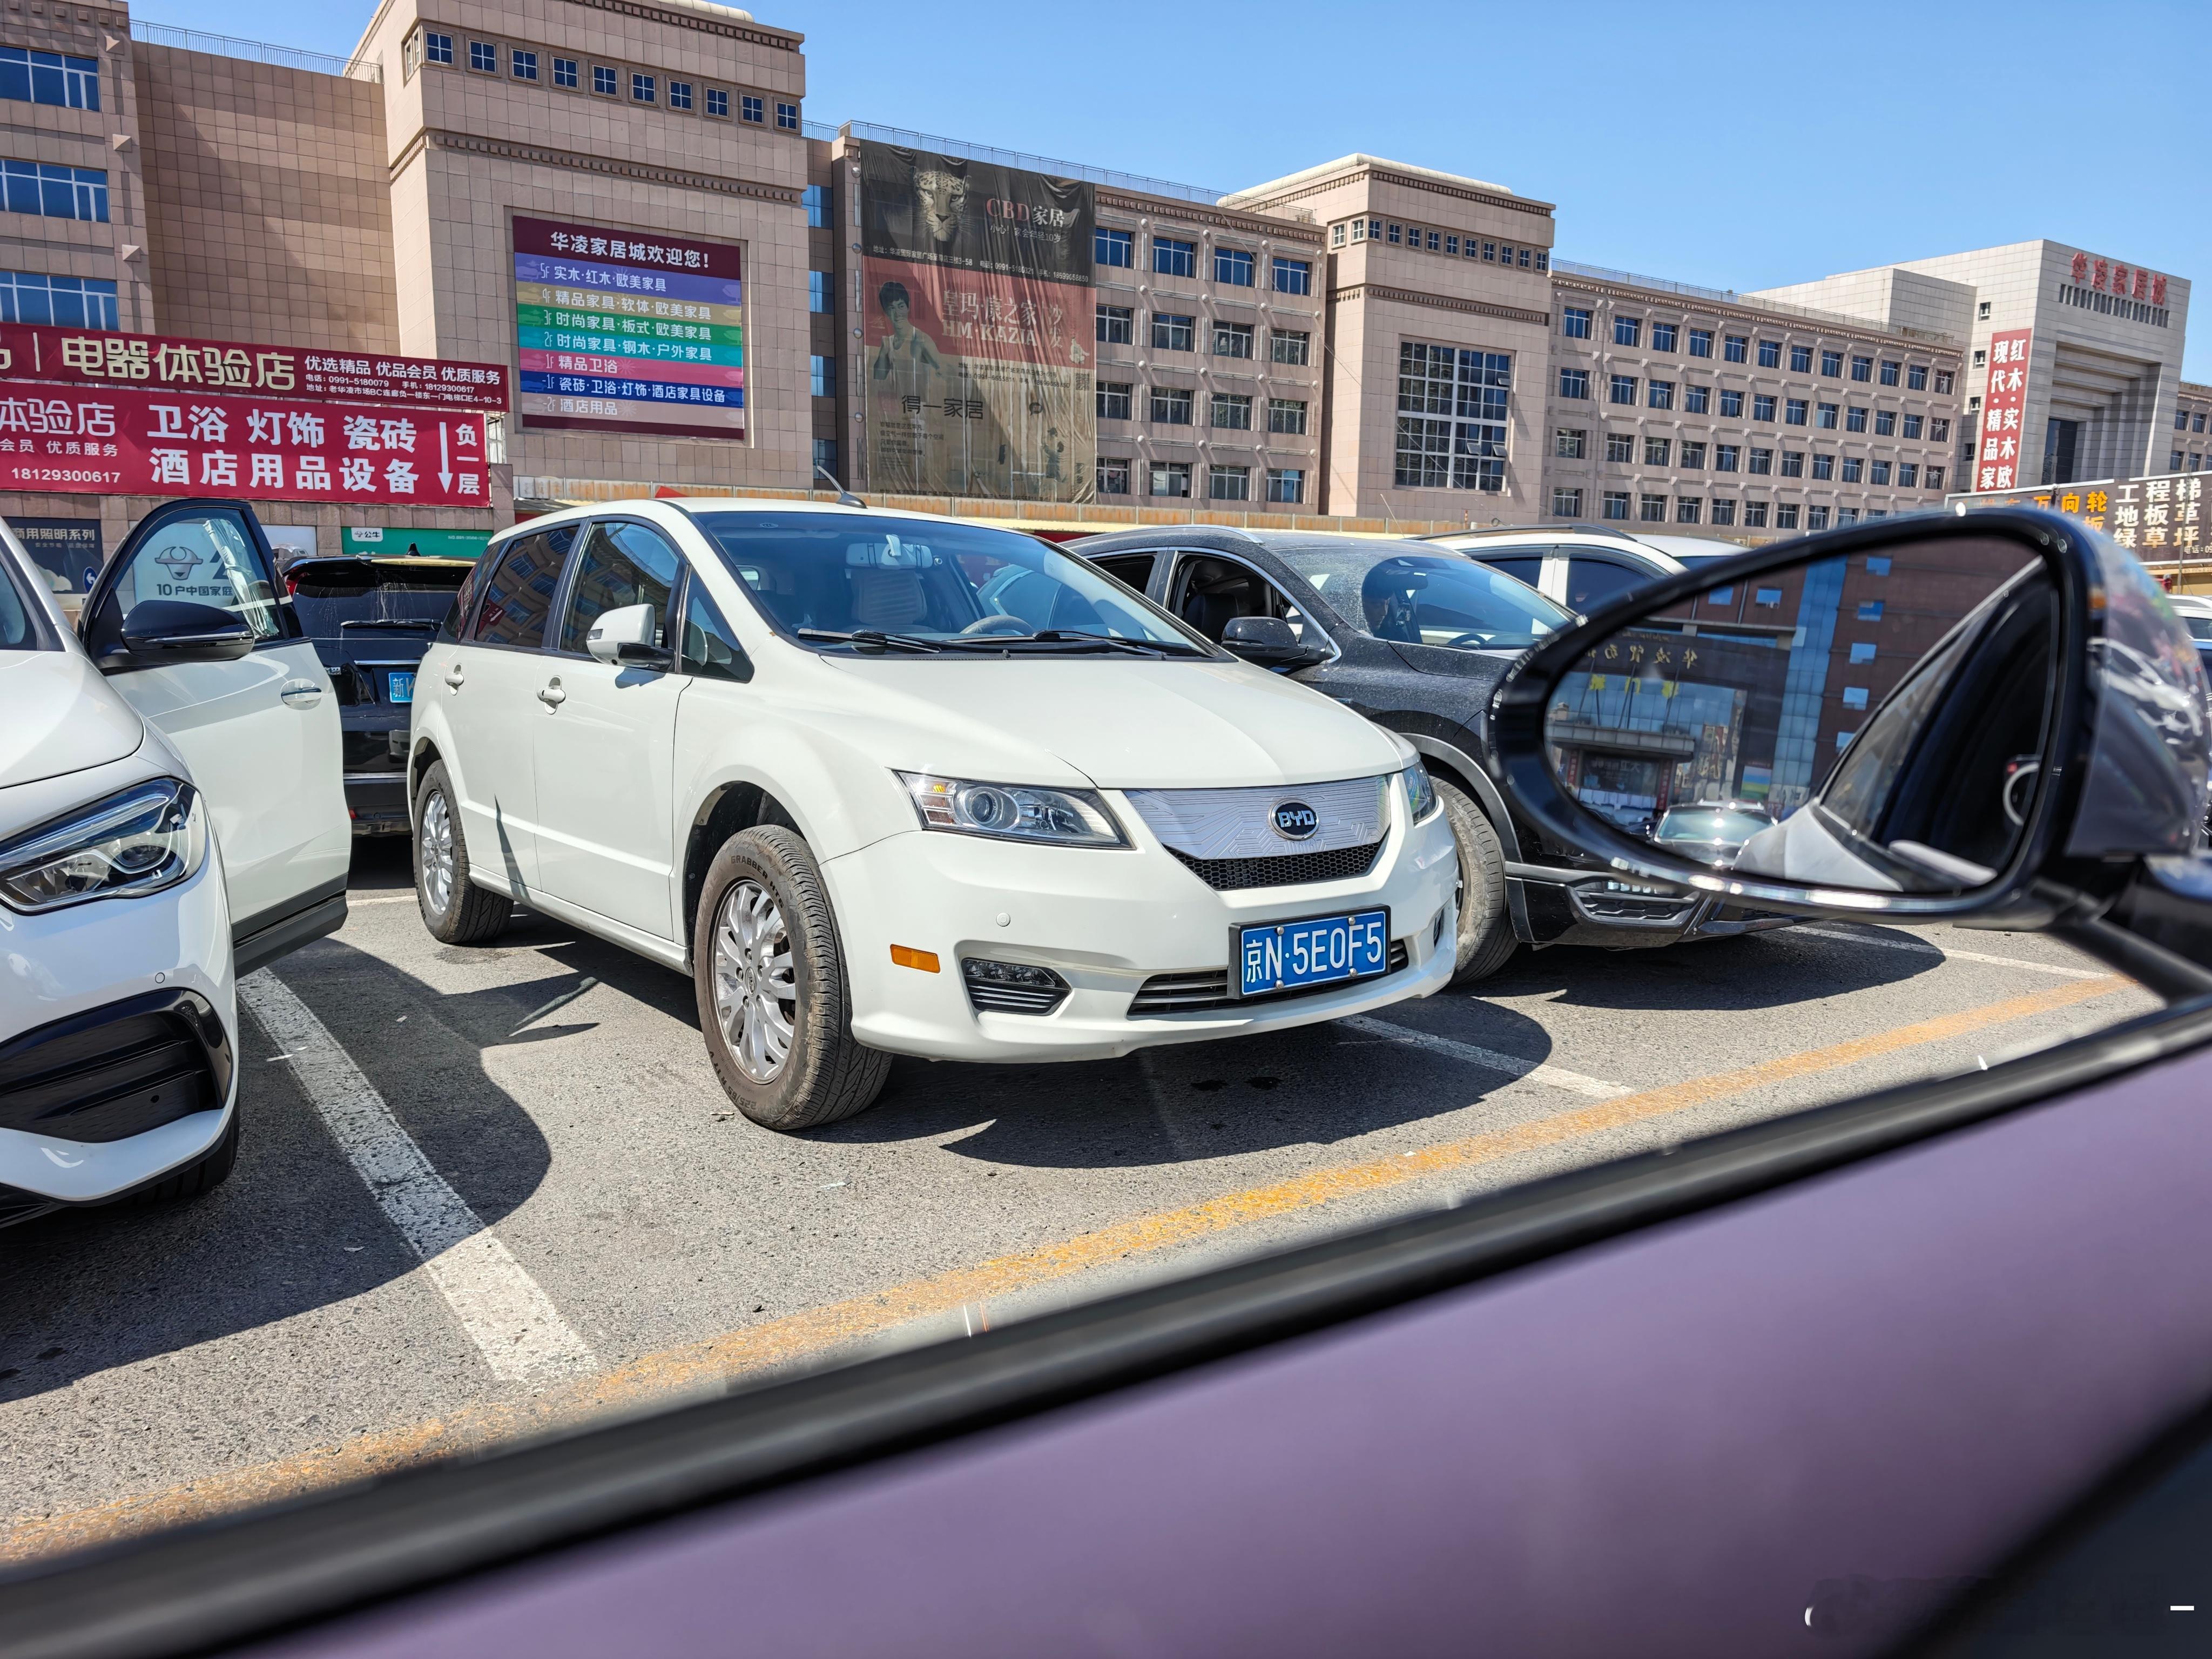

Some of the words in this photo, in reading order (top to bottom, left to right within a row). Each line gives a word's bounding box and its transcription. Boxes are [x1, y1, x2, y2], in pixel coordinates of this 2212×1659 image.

[550, 232, 709, 268] 华凌家居城欢迎您！
[541, 262, 549, 279] 5F
[554, 266, 667, 292] 实木·红木·欧美家具
[2072, 252, 2167, 306] 华凌家居城
[543, 288, 550, 304] 4F
[556, 289, 712, 320] 精品家具·软体·欧美家具
[544, 309, 551, 325] 3F
[556, 312, 712, 341] 时尚家具·板式·欧美家具
[544, 331, 553, 347] 2F
[557, 333, 712, 361] 时尚家具·钢木·户外家具
[61, 335, 295, 391] 电器体验店
[305, 355, 370, 375] 优选精品
[376, 362, 437, 381] 优品会员
[441, 367, 500, 385] 优质服务
[545, 353, 554, 369] 1F
[558, 355, 618, 374] 精品卫浴
[306, 374, 389, 387] 电话：0991-5180079
[402, 381, 474, 394] 手机：18129300617
[542, 374, 555, 389] -1F
[559, 377, 725, 403] 瓷砖·卫浴·灯饰·酒店家具设备
[543, 396, 555, 413] -2F
[560, 399, 618, 416] 酒店用品
[902, 395, 983, 419] 得一家居
[147, 404, 227, 442] 卫浴
[247, 412, 325, 448] 灯饰
[342, 414, 417, 453] 瓷砖
[46, 441, 118, 456] 优质服务
[456, 423, 480, 496] 负一层
[11, 468, 120, 483] 18129300617
[149, 447, 420, 494] 酒店用品设备
[2115, 478, 2202, 503] 工程梯
[2114, 503, 2201, 527] 地板革
[2113, 525, 2200, 549] 绿草坪
[1278, 810, 1316, 828] BYD
[731, 855, 768, 880] GRABBER
[727, 1085, 757, 1110] 225/65
